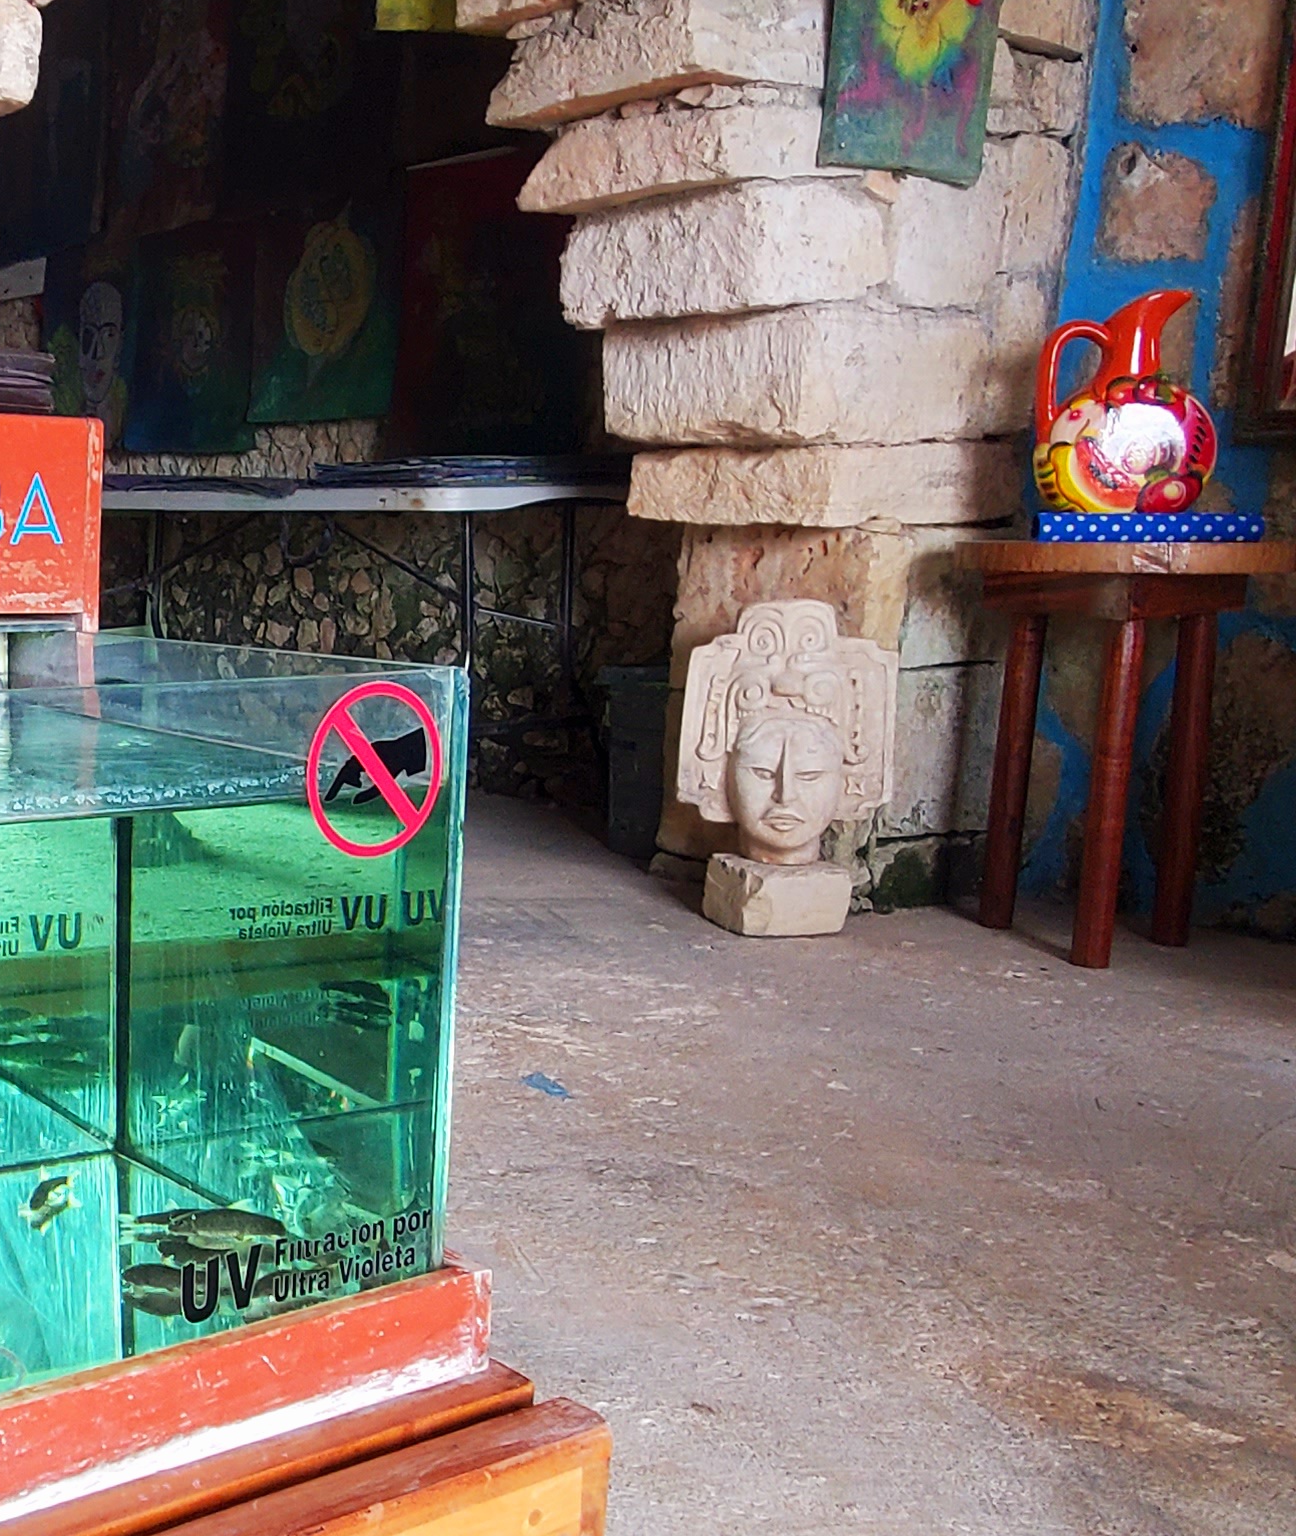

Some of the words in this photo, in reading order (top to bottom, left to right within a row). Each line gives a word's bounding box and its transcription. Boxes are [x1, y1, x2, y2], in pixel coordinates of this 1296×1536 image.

[393, 1209, 432, 1242] por
[181, 1244, 262, 1324] UV
[274, 1270, 331, 1303] Ultra
[338, 1245, 416, 1285] Violeta
